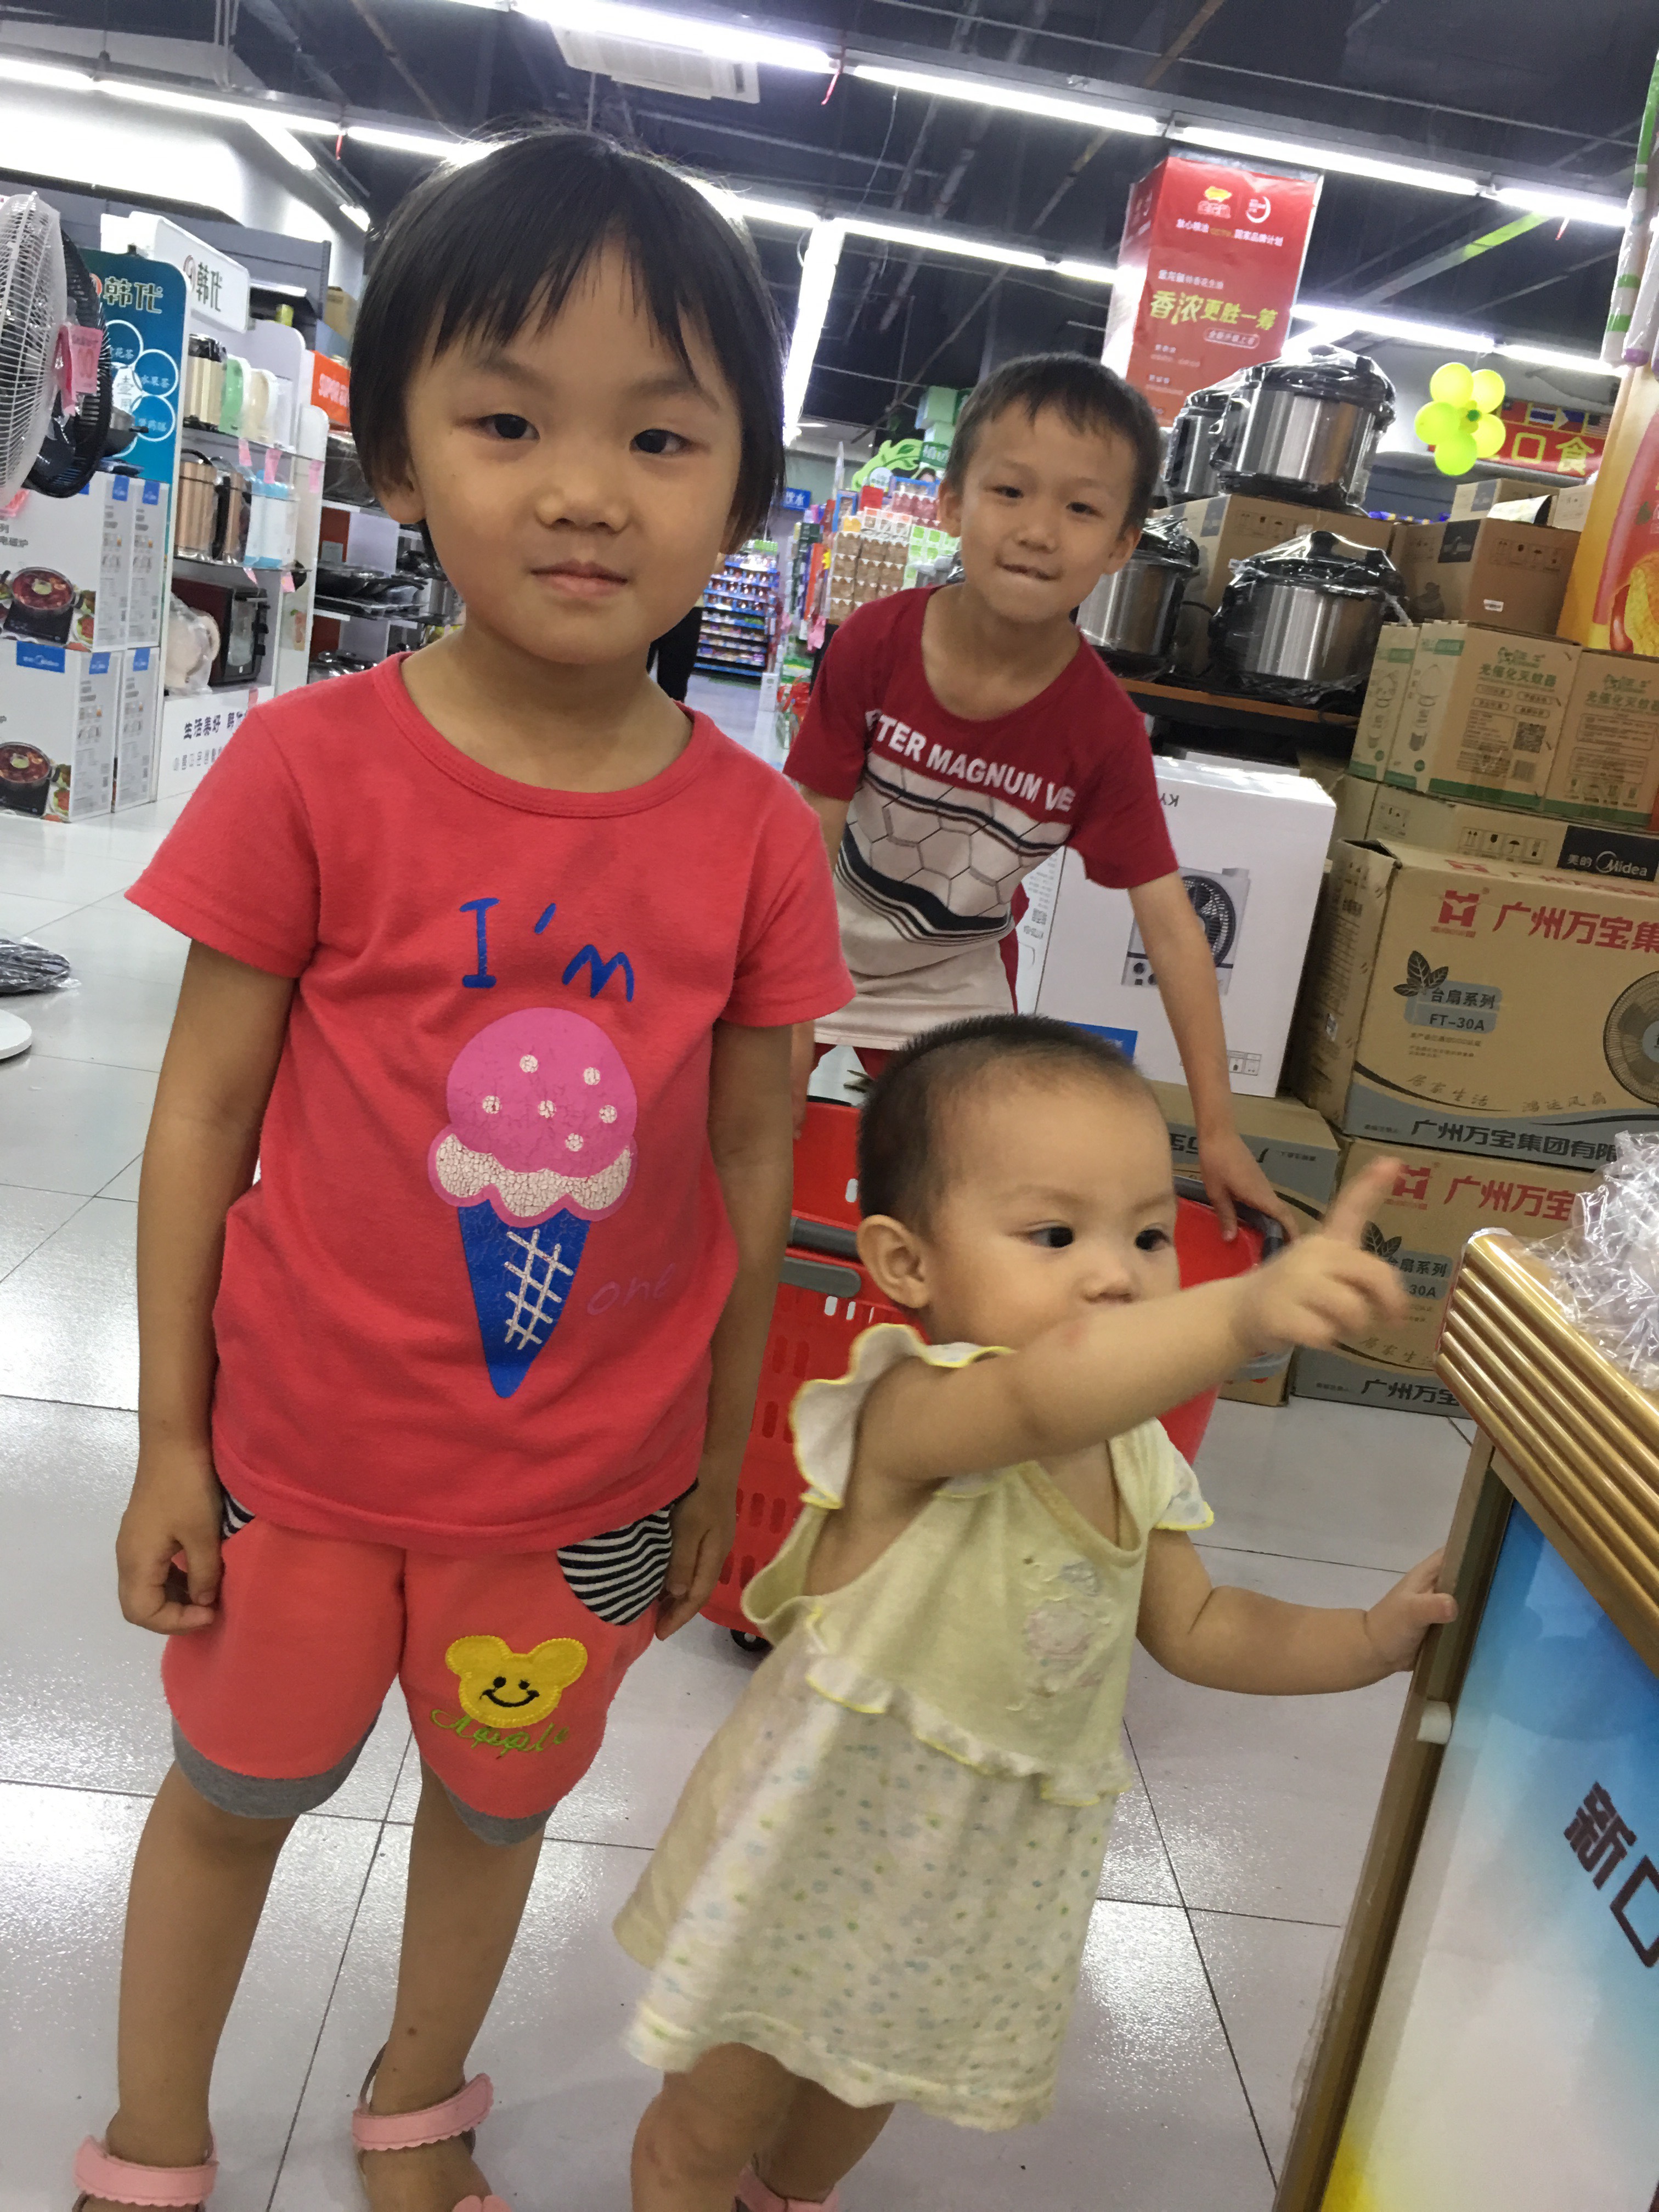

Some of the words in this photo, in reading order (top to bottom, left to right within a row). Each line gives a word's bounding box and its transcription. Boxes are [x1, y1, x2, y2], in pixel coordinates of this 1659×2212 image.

[1480, 432, 1595, 476] 口食
[927, 743, 1043, 803] MAGNUM
[1566, 853, 1593, 868] 美的
[1596, 853, 1647, 877] Midea
[1430, 988, 1496, 1009] 台扇系列
[1429, 1013, 1486, 1032] FT-30A
[1411, 1119, 1618, 1163] 广州万宝集团有限
[1444, 1175, 1575, 1222] 广州万宝
[1361, 1379, 1460, 1407] 广州万宝
